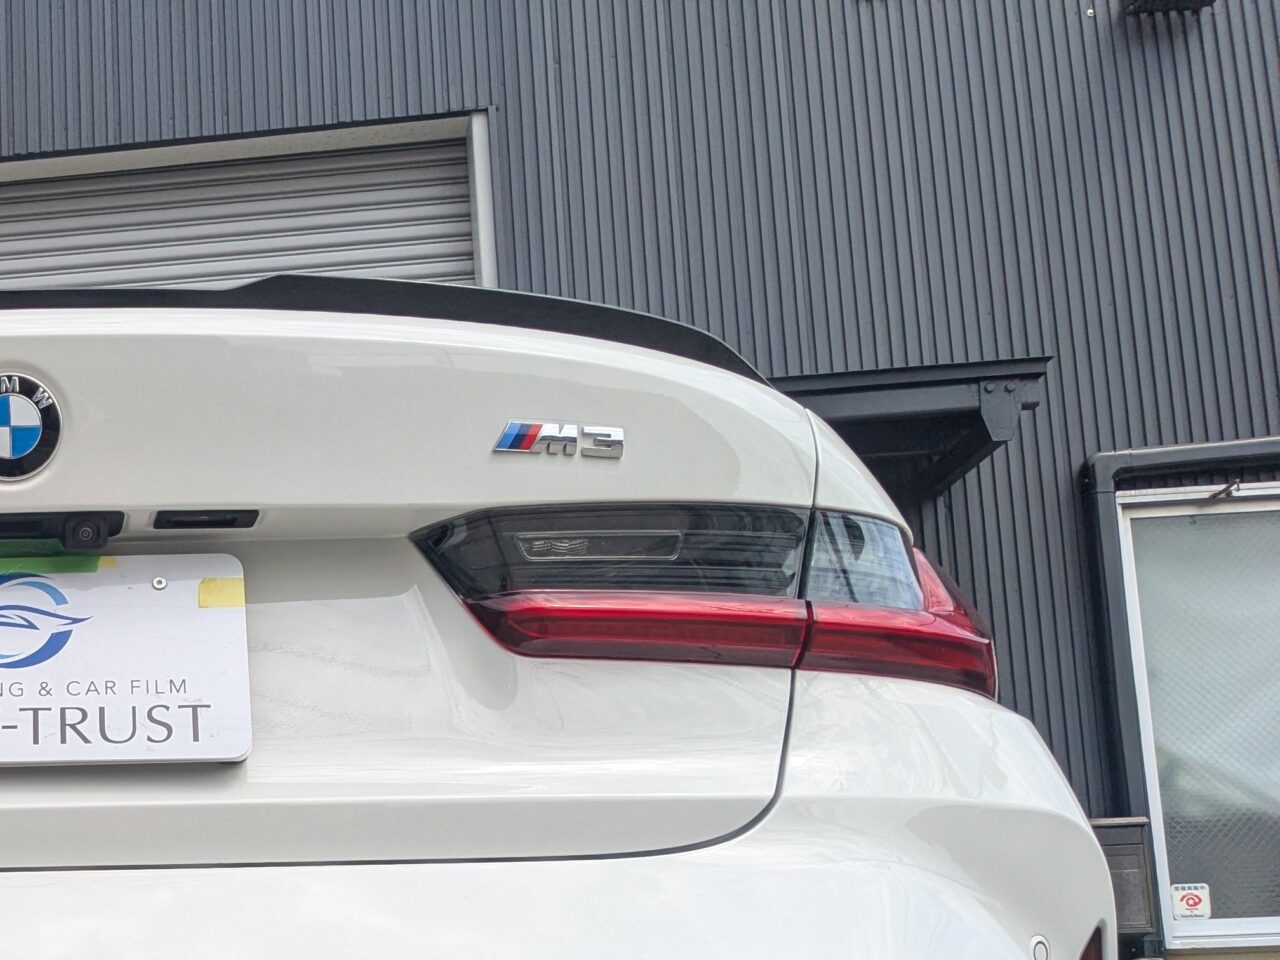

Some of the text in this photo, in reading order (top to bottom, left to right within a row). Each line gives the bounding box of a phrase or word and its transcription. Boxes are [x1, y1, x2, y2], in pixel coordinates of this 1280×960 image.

[529, 422, 625, 458] M3
[38, 681, 53, 697] &
[66, 680, 117, 696] CAR
[130, 679, 187, 695] FILM
